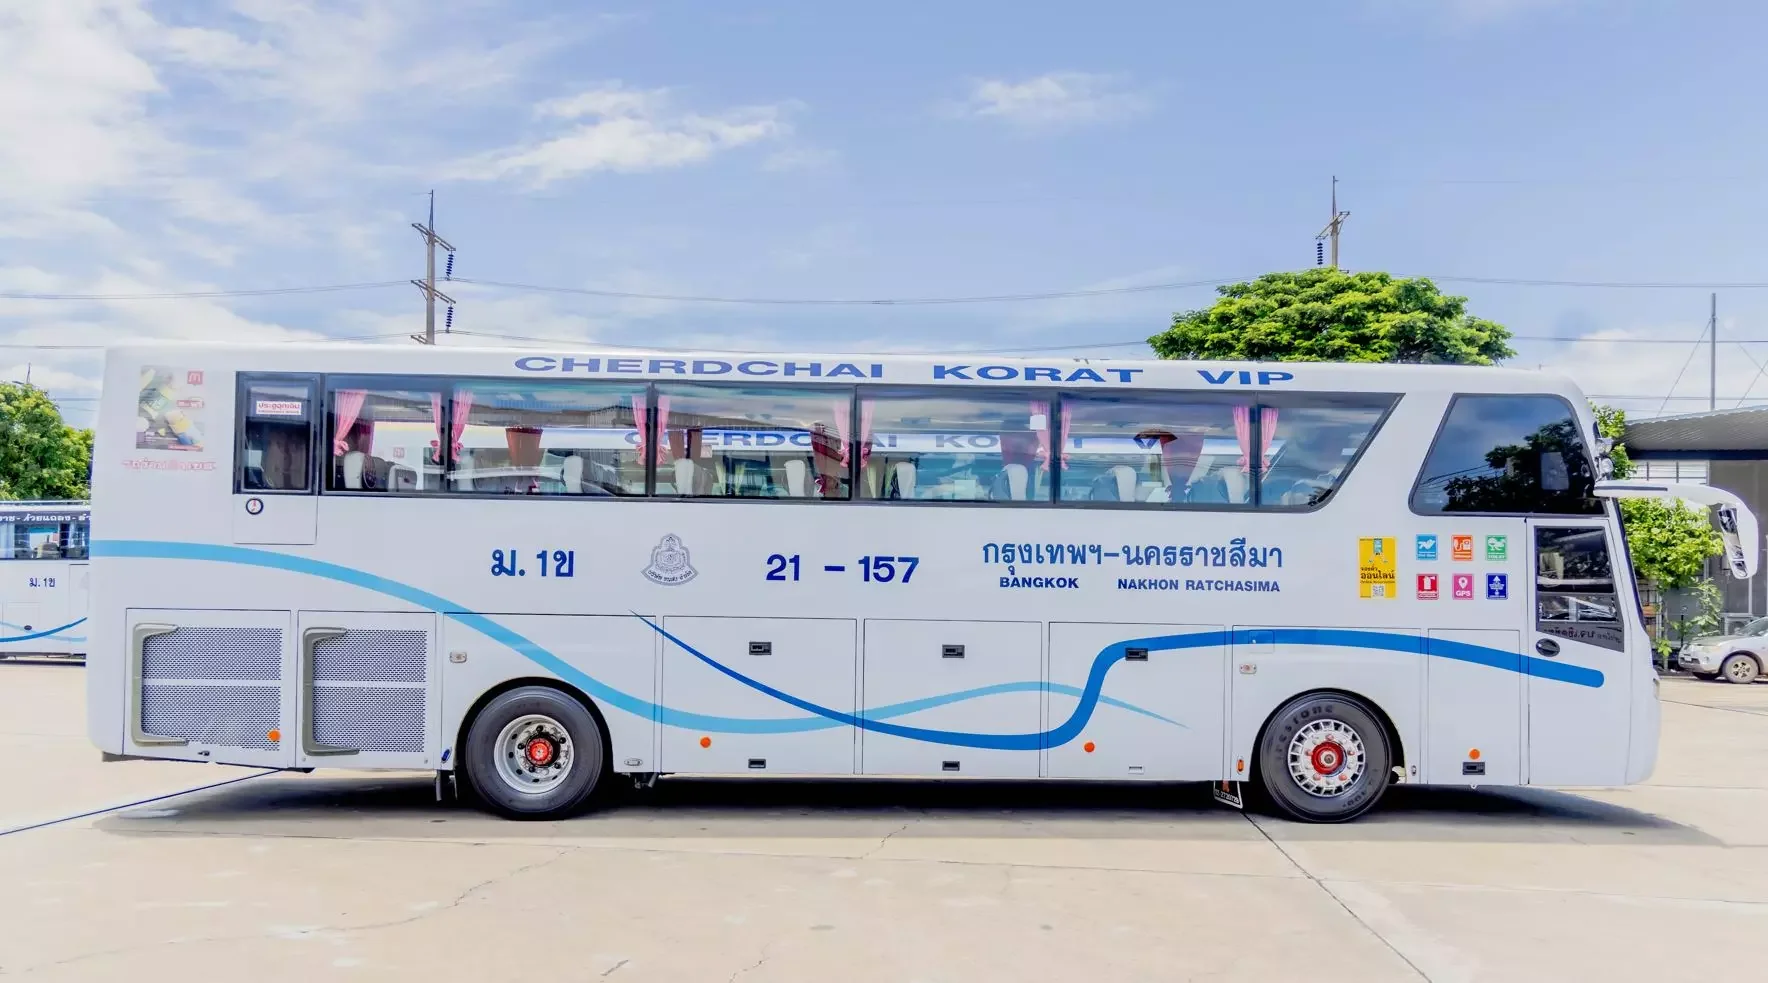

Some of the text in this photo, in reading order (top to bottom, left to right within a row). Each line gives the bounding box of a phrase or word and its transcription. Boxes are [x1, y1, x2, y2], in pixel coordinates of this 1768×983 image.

[515, 356, 1295, 386] CHERDCHAI KORAT VIP
[765, 553, 801, 582] 21
[857, 555, 920, 584] 157
[1360, 570, 1396, 580] ออนไลน์
[999, 576, 1281, 592] BANGKOK NAKHON RATCHASIMA
